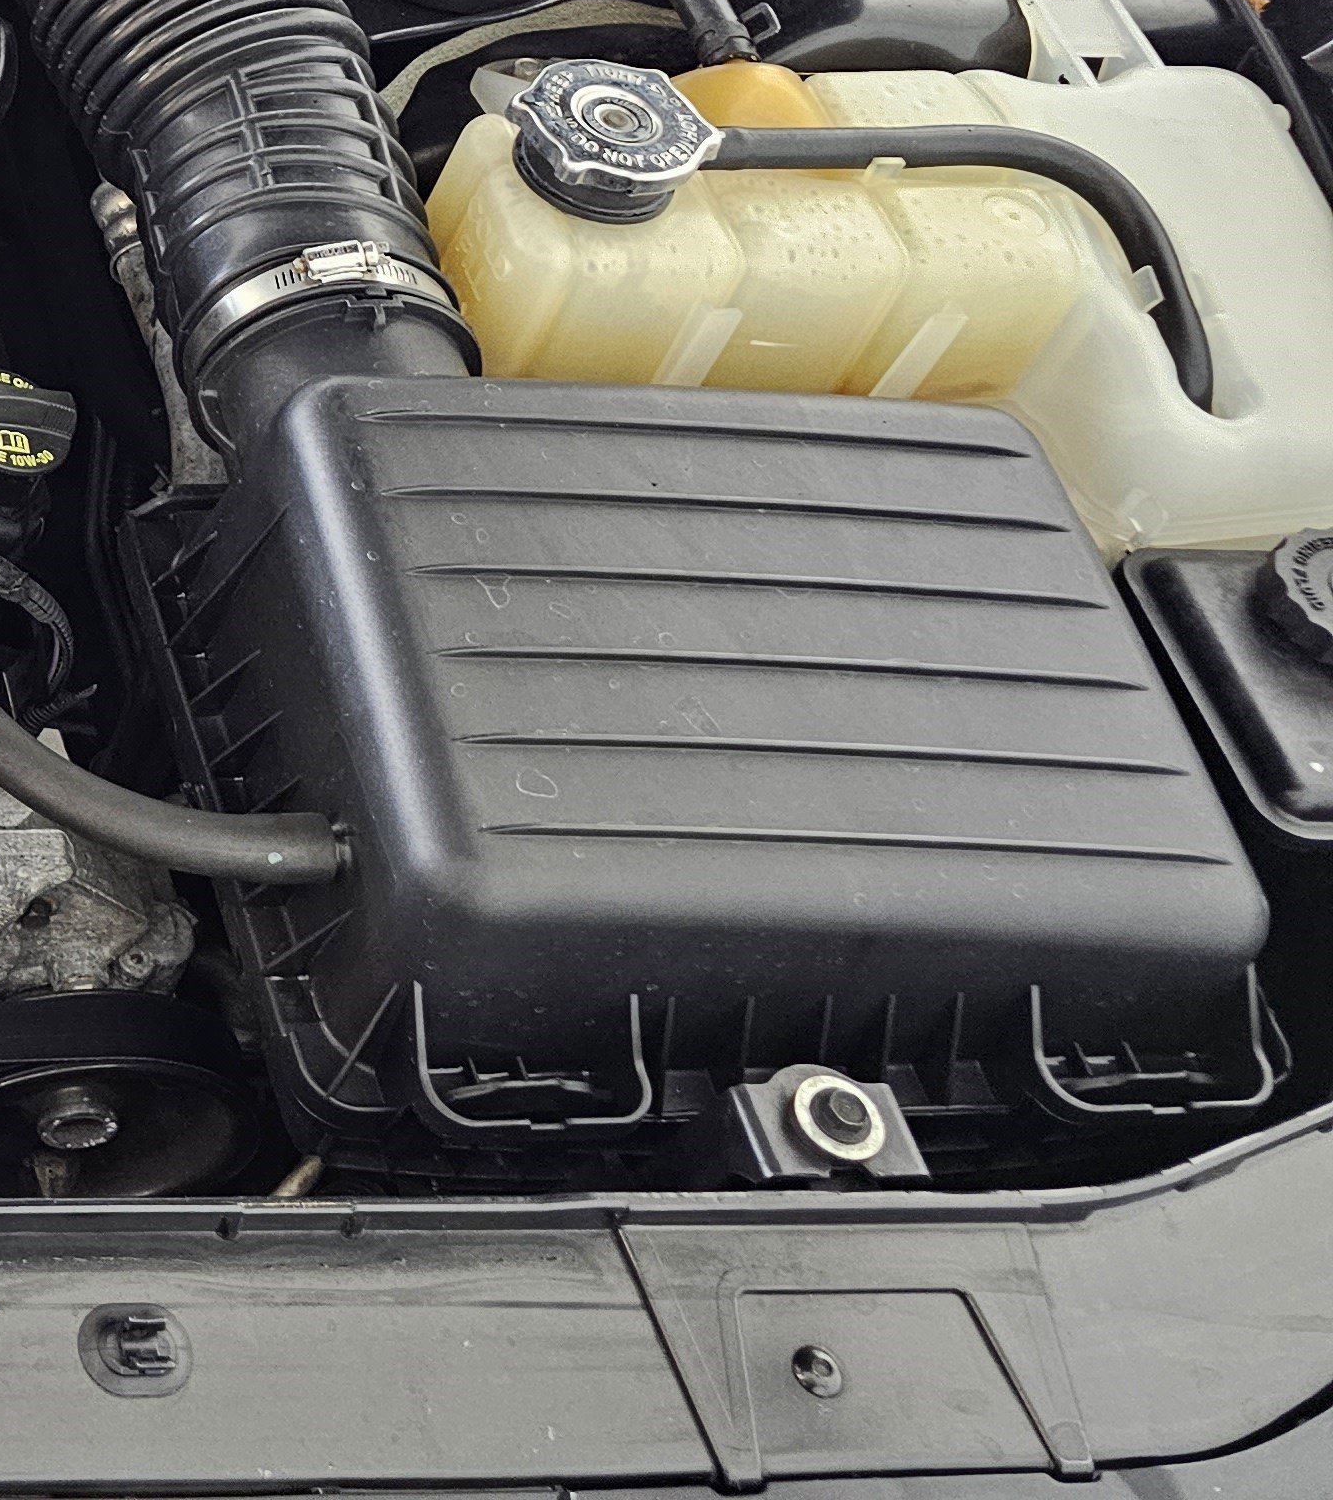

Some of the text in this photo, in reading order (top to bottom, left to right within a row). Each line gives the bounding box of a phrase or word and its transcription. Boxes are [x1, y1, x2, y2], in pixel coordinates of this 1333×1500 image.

[571, 132, 600, 153] DO
[603, 147, 645, 169] NOT
[10, 449, 55, 467] 10W-30
